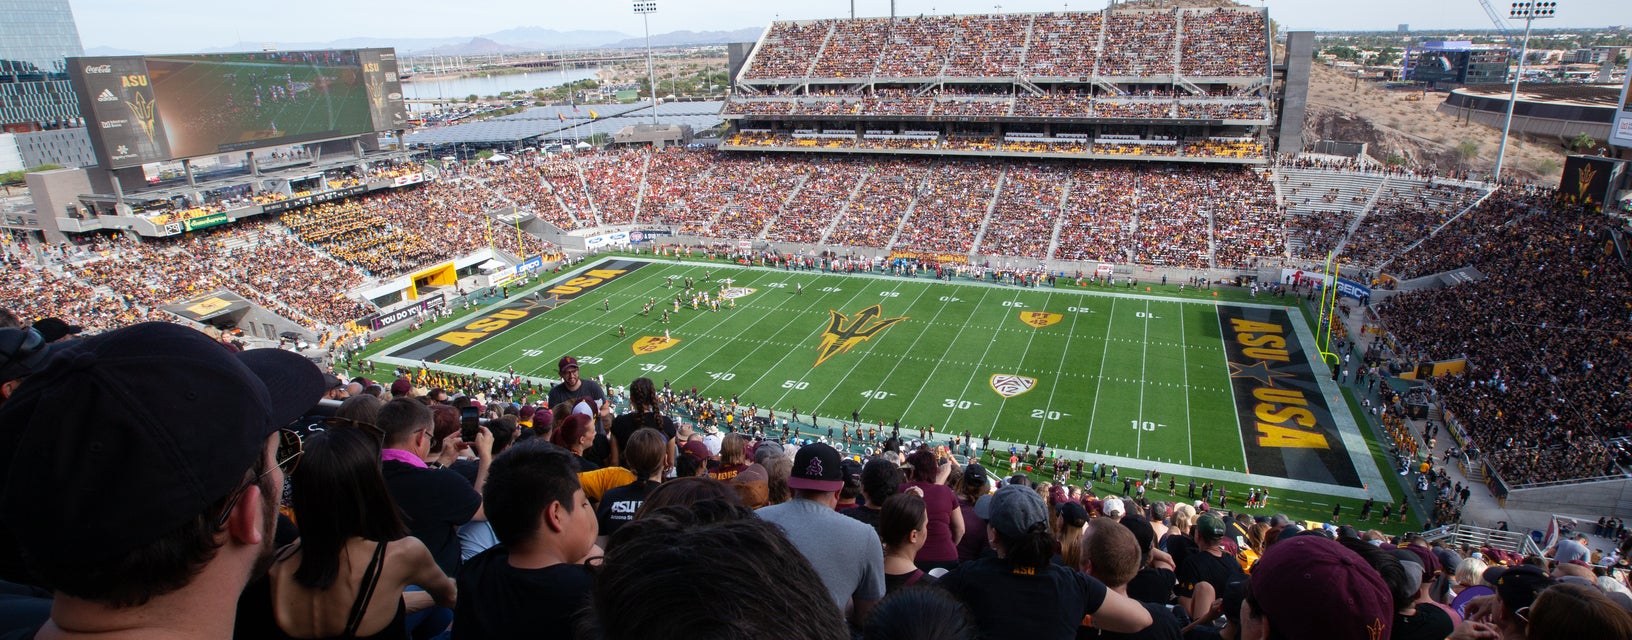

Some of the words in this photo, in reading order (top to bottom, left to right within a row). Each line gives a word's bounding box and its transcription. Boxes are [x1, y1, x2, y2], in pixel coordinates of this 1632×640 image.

[363, 63, 380, 72] ASU
[121, 75, 148, 88] ASU
[547, 269, 628, 295] USA
[1002, 300, 1024, 308] 30
[381, 315, 396, 326] YOU
[396, 310, 408, 320] DO
[407, 304, 422, 316] YOU
[435, 309, 529, 347] ASU
[1230, 318, 1290, 362] ASU
[522, 349, 544, 357] 10
[577, 356, 603, 365] 20
[640, 363, 667, 373] 30
[709, 371, 736, 381] 40
[781, 380, 810, 390] 50
[860, 389, 888, 400] 40
[942, 399, 972, 410] 30
[1031, 409, 1061, 420] 20
[1253, 387, 1331, 449] USA
[1131, 420, 1156, 431] 10
[611, 501, 636, 513] ASU
